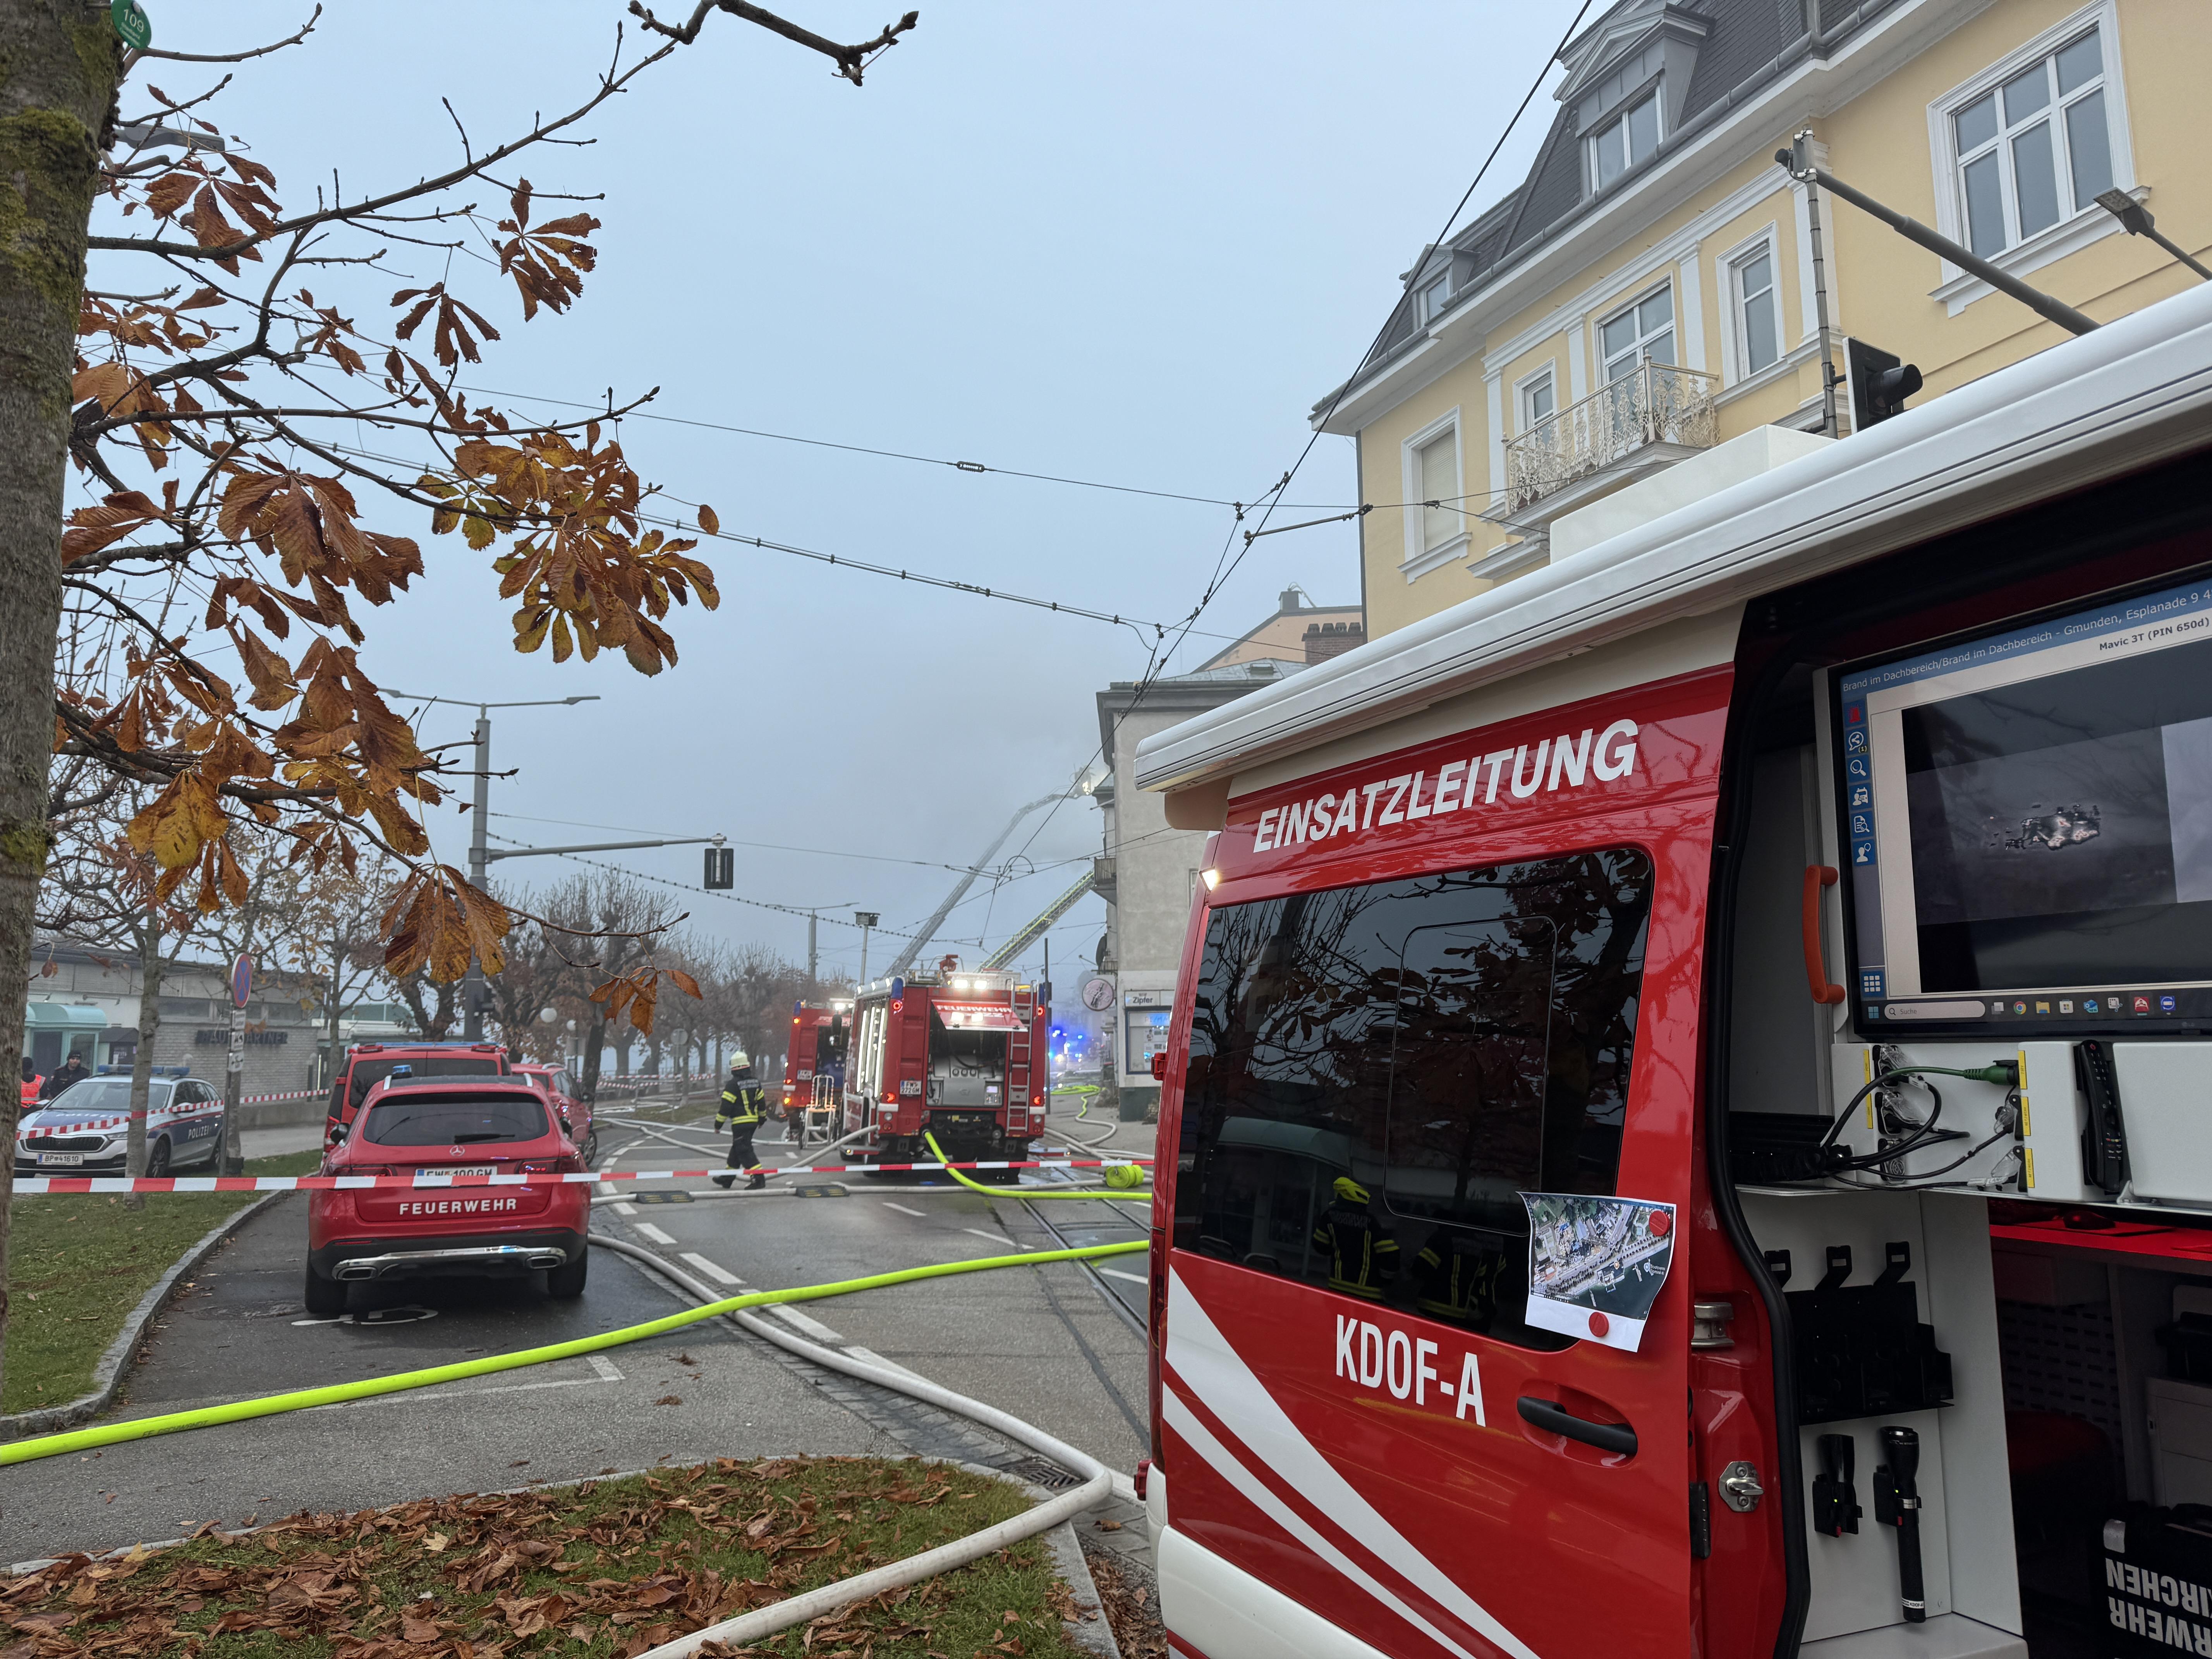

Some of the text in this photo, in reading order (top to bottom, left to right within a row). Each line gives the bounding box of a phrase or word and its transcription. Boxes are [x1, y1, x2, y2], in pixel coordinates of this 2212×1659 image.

[124, 9, 144, 33] 109
[1843, 678, 1867, 692] Brand
[1870, 676, 1881, 685] im
[1884, 653, 1970, 682] Dachbereich/Brand
[1974, 648, 1985, 658] im
[1989, 631, 2052, 656] Dachbereich
[2064, 614, 2122, 635] Gmunden,
[2126, 597, 2187, 620] Esplanade
[2191, 593, 2199, 603] 9
[2203, 589, 2212, 599] 4
[2099, 617, 2210, 651] Mavic 3T (PIN 650d)
[1253, 719, 1638, 853] EINSATZLEITUNG
[1133, 996, 1153, 1005] Zipfer
[197, 1030, 288, 1044] BAUARTNER
[188, 1125, 210, 1140] POLIZEI
[399, 1198, 517, 1215] FEUERWEHR
[1336, 1314, 1486, 1427] KDOF-A
